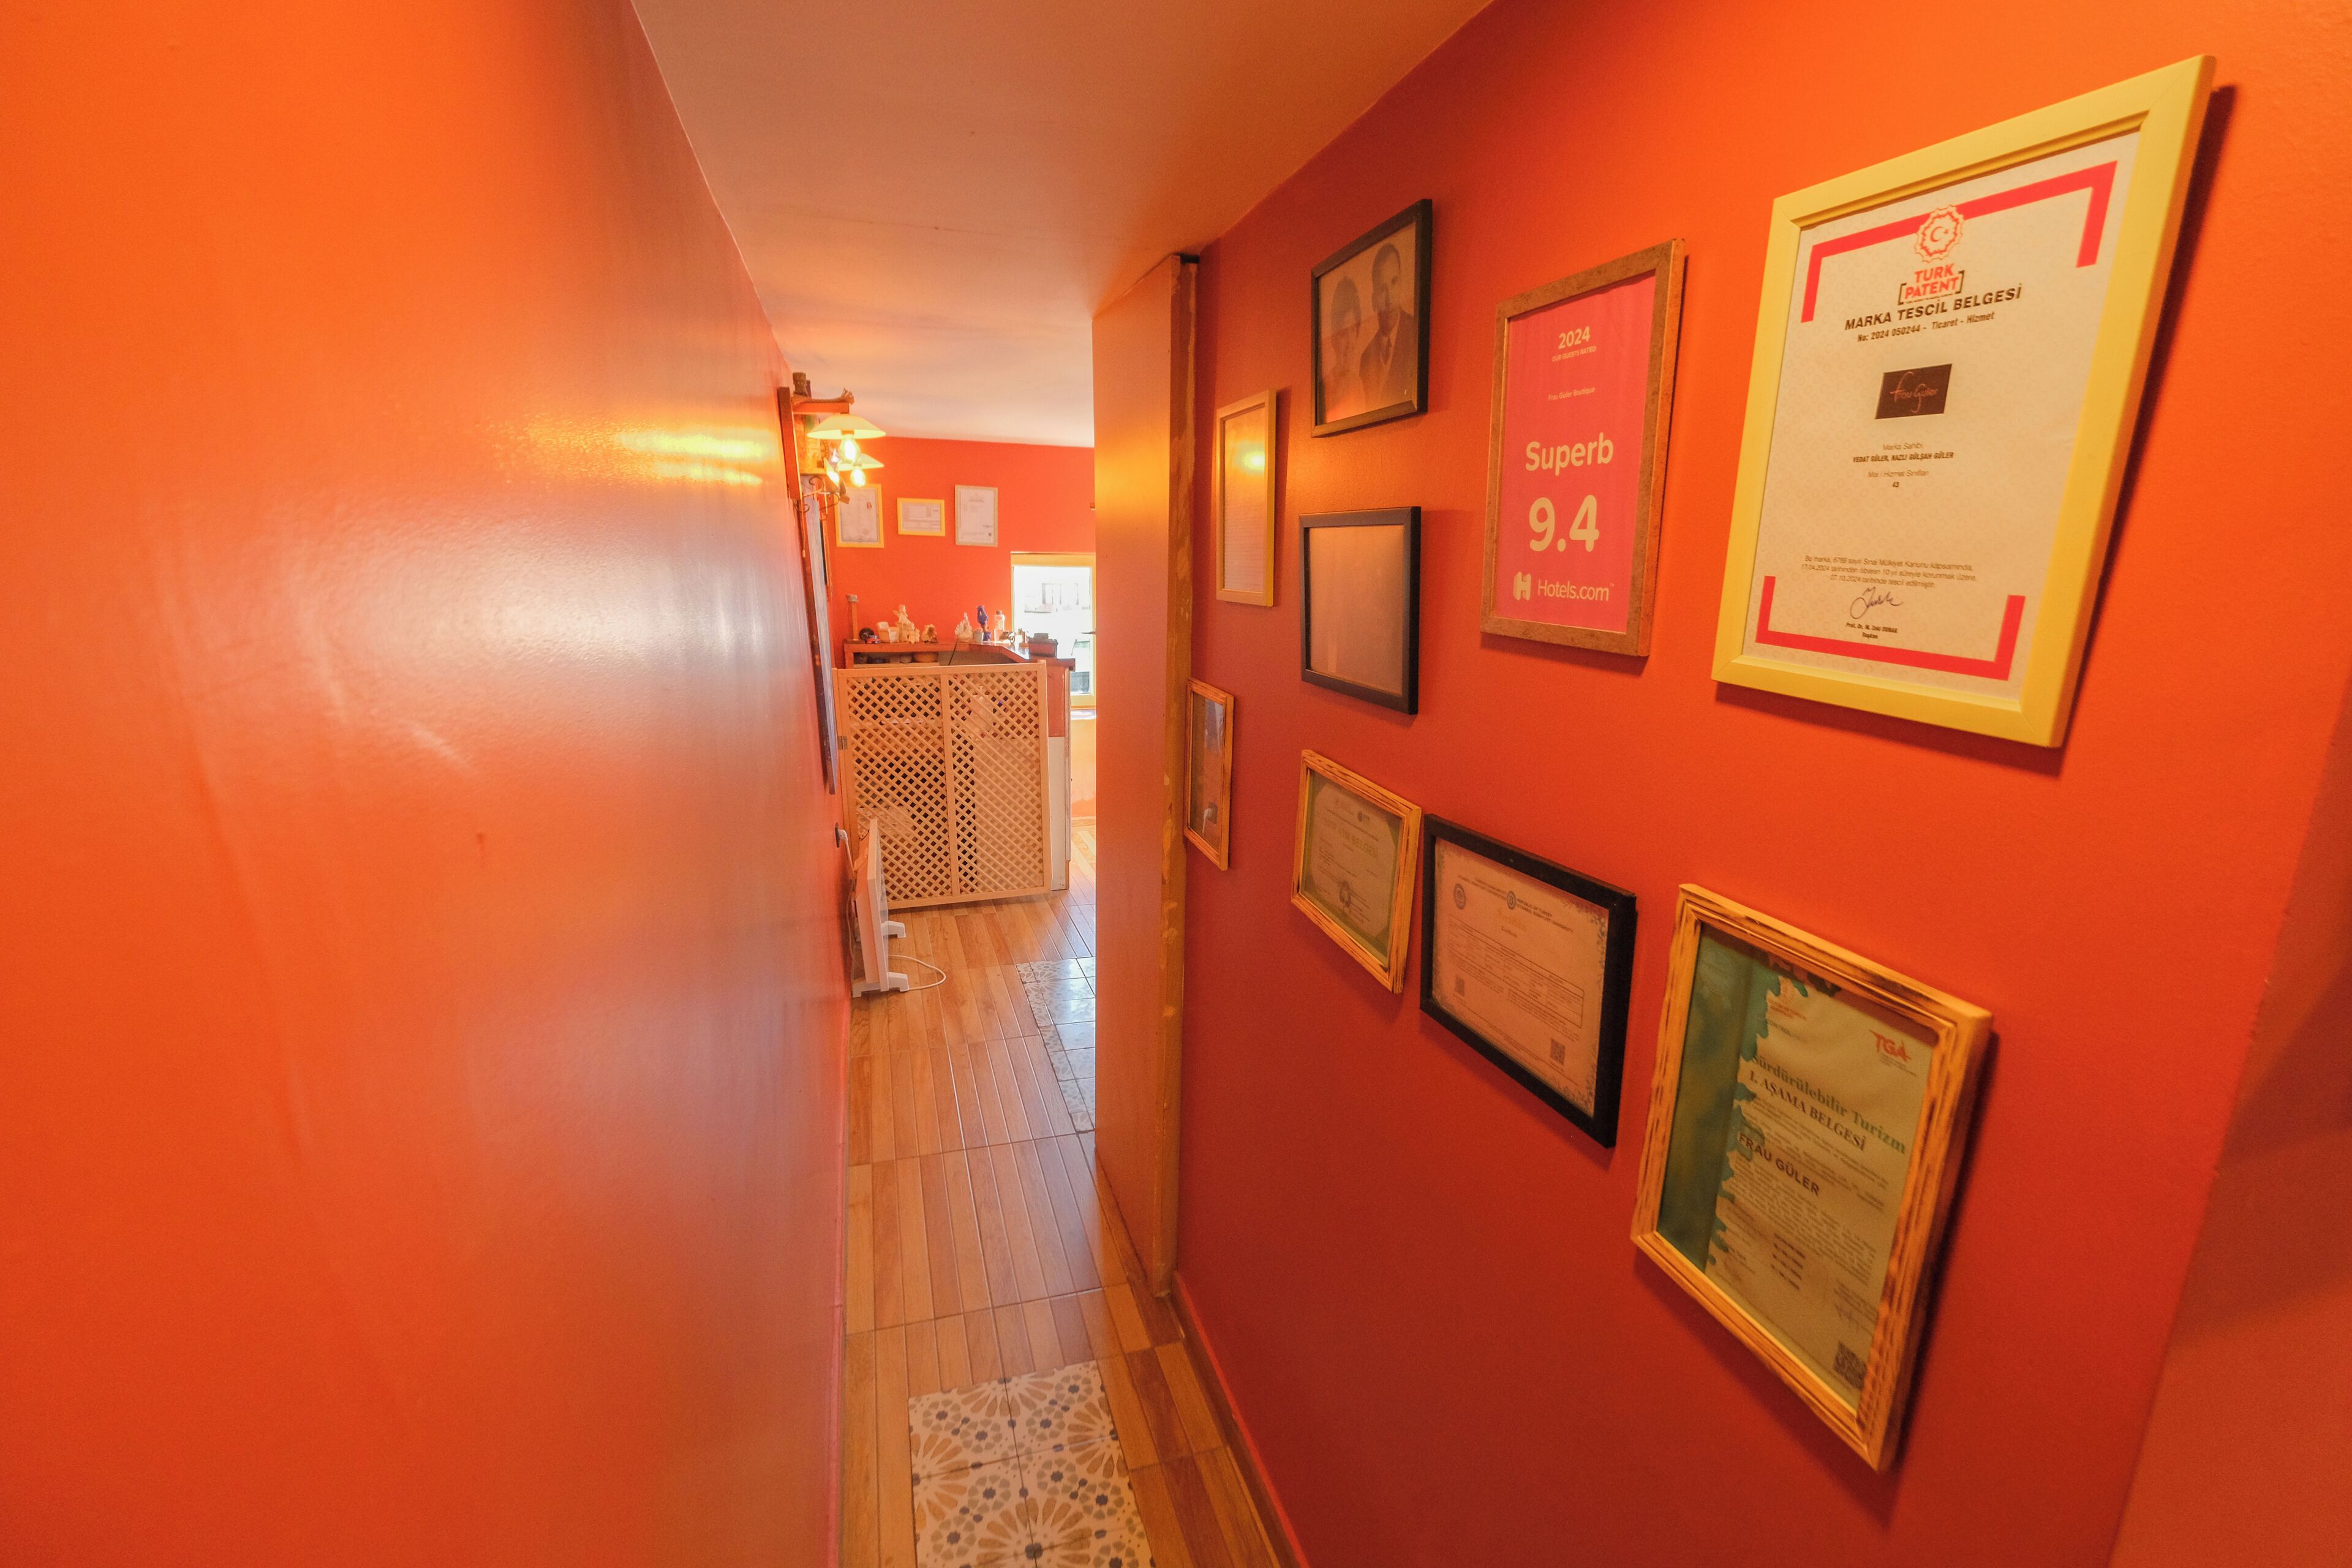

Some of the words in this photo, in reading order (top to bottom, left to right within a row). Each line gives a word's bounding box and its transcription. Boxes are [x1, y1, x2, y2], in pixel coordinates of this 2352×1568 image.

[1904, 276, 1959, 299] PATENT
[1844, 312, 1892, 331] MARKA
[1897, 299, 1948, 321] TESCİL
[1953, 283, 2022, 311] BELGESİ
[1558, 325, 1591, 349] 2024
[1871, 329, 1890, 340] 2024
[1931, 317, 1958, 330] Ticaret
[1966, 311, 1996, 324] Hizmet
[1562, 350, 1580, 360] GUESTS
[1580, 345, 1597, 355] RATED
[1573, 387, 1596, 396] Boutique
[1525, 432, 1614, 477] Superb
[1529, 494, 1600, 552] 9.4
[1537, 578, 1610, 602] Hotels.com
[1869, 1030, 1912, 1062] TGA
[1752, 1055, 1848, 1118] Sürdürülebilir
[1852, 1110, 1906, 1155] Turizm
[1762, 1078, 1808, 1114] AŞAMA
[1809, 1106, 1868, 1152] BELGESİ
[1739, 1133, 1772, 1162] FRAU
[1775, 1157, 1820, 1197] GÜLER
